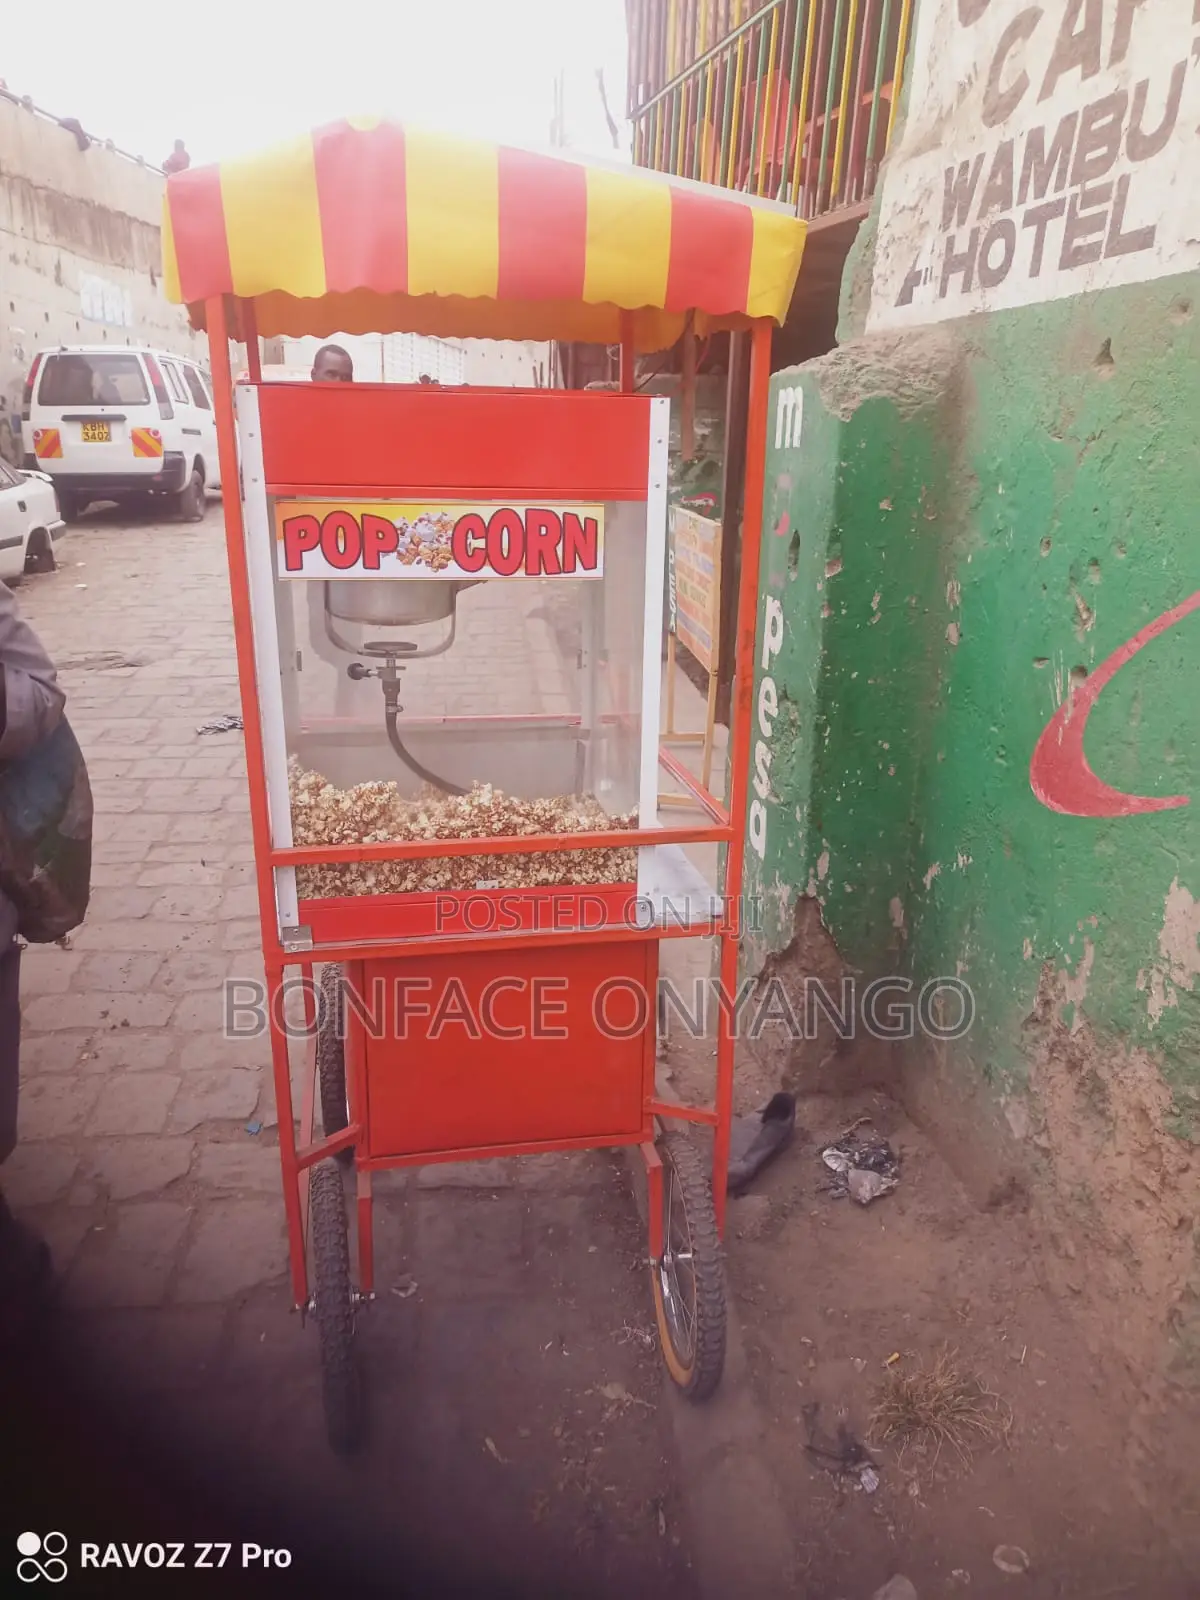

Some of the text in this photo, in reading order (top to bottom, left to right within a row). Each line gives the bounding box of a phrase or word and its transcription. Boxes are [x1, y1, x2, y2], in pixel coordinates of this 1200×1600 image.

[938, 173, 1157, 299] HOTEL
[282, 507, 599, 577] POP CORN
